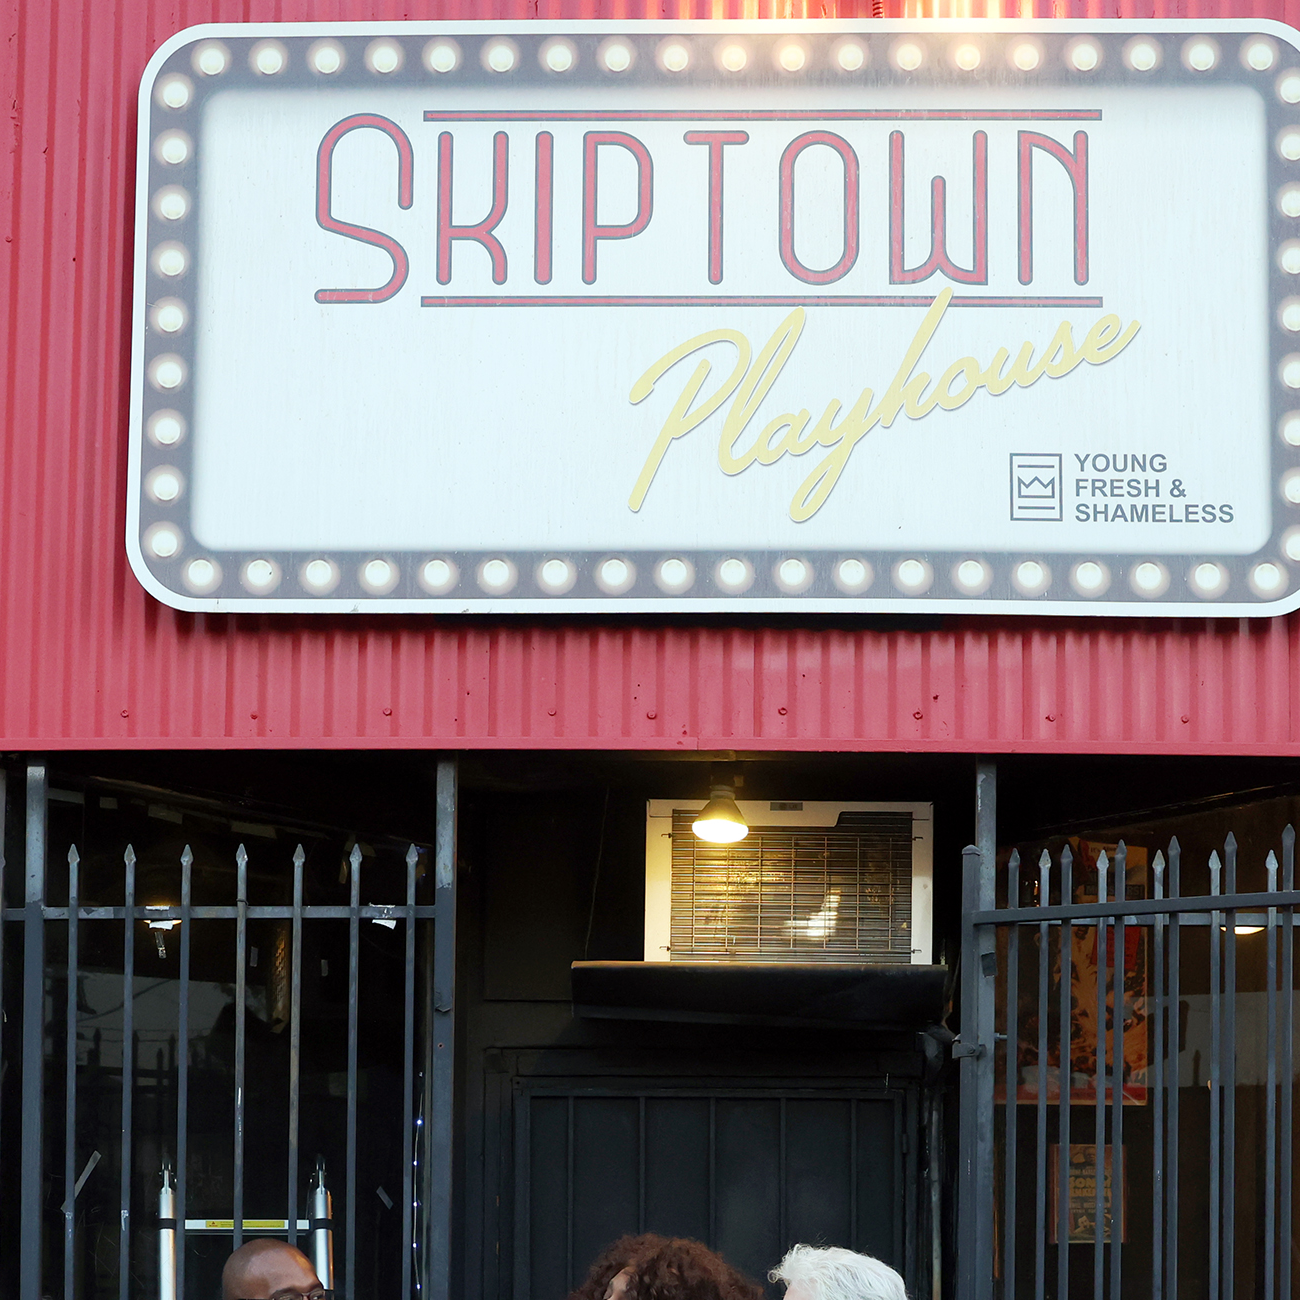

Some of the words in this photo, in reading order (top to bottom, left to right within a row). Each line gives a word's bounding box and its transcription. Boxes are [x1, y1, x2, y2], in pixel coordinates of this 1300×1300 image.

[628, 287, 1141, 523] Playhouse
[1074, 453, 1167, 472] YOUNG
[1075, 479, 1160, 498] FRESH
[1169, 479, 1187, 498] &
[1075, 504, 1235, 523] SHAMELESS
